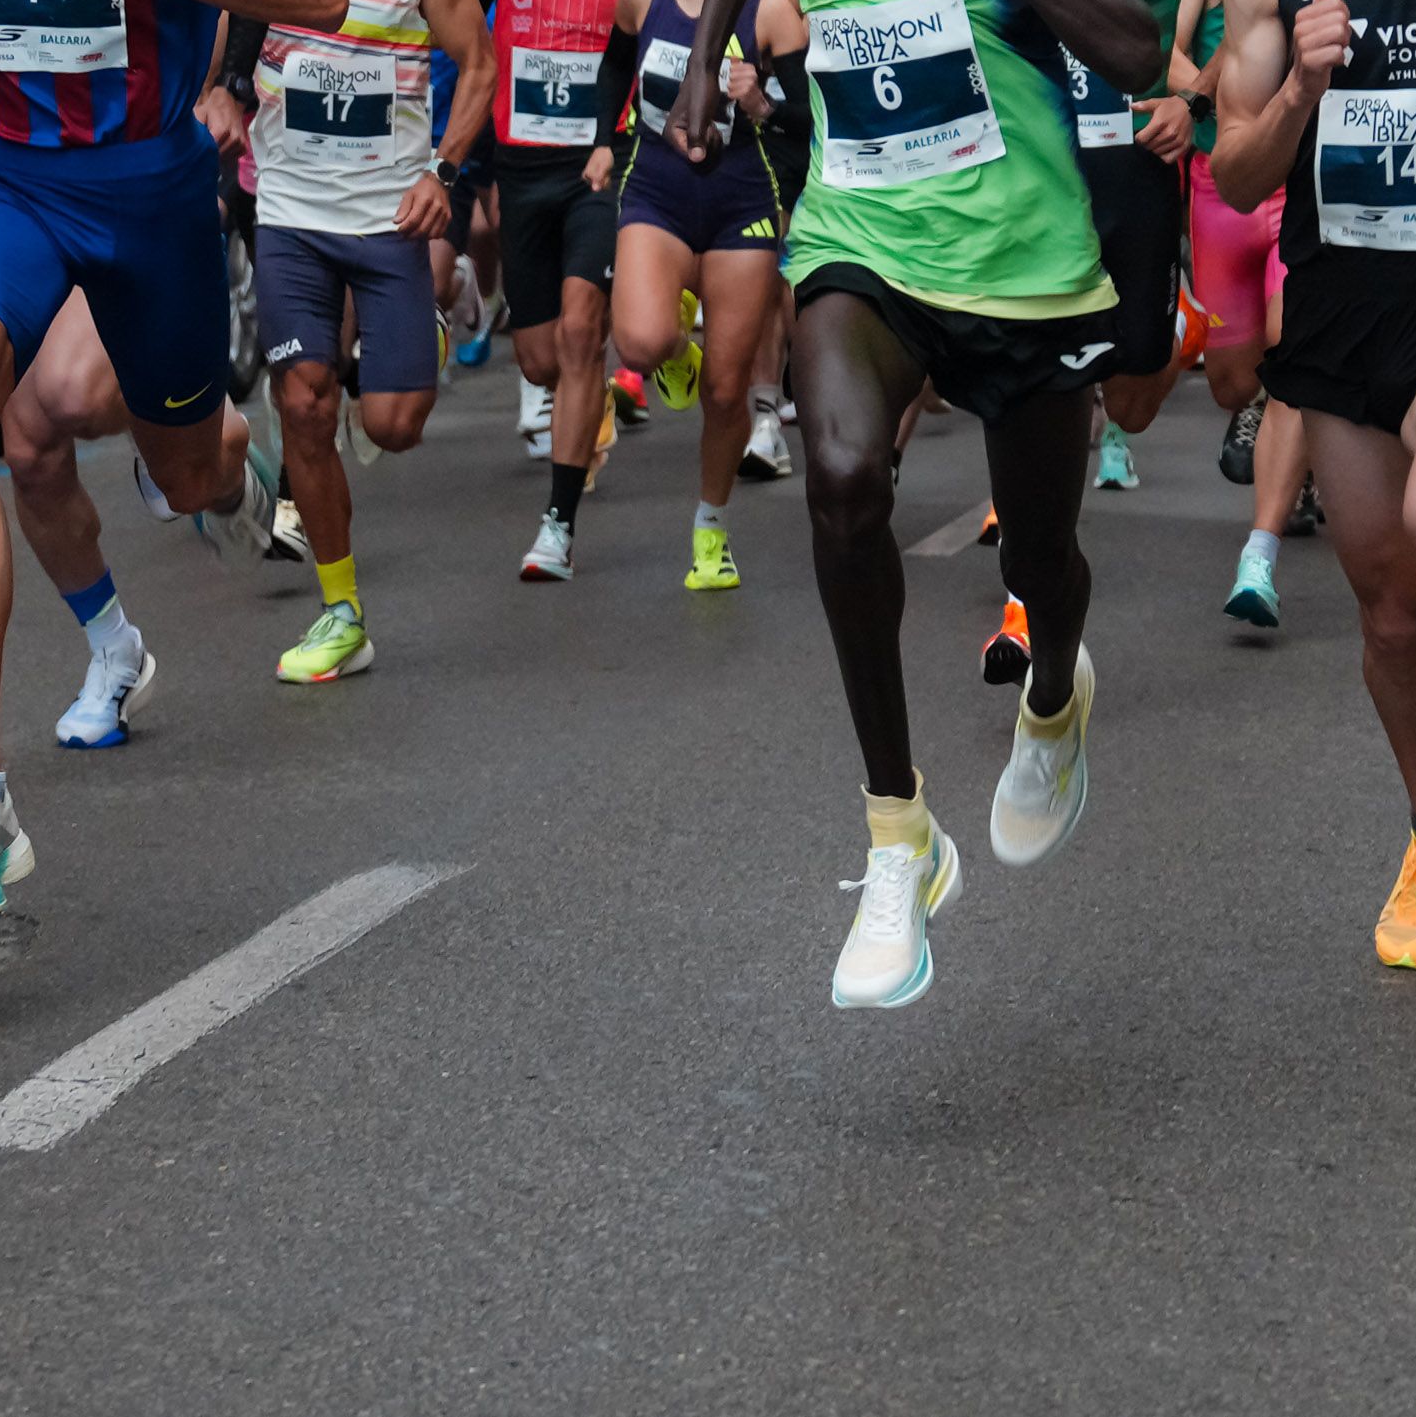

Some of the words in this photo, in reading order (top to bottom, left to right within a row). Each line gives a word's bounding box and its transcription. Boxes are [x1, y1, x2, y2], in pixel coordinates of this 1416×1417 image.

[820, 18, 862, 33] CURSA
[822, 11, 943, 52] PATRIMONI
[300, 58, 332, 70] CURSA
[525, 58, 593, 72] PATRIMONI
[850, 42, 909, 67] IBIZA
[299, 65, 381, 83] PATRIMONI
[319, 79, 357, 92] IBIZA
[966, 63, 985, 95] 2026
[543, 81, 570, 108] 15
[872, 65, 903, 111] 6
[322, 93, 355, 123] 17
[1345, 98, 1391, 112] CURSA
[266, 338, 303, 365] HOKA
